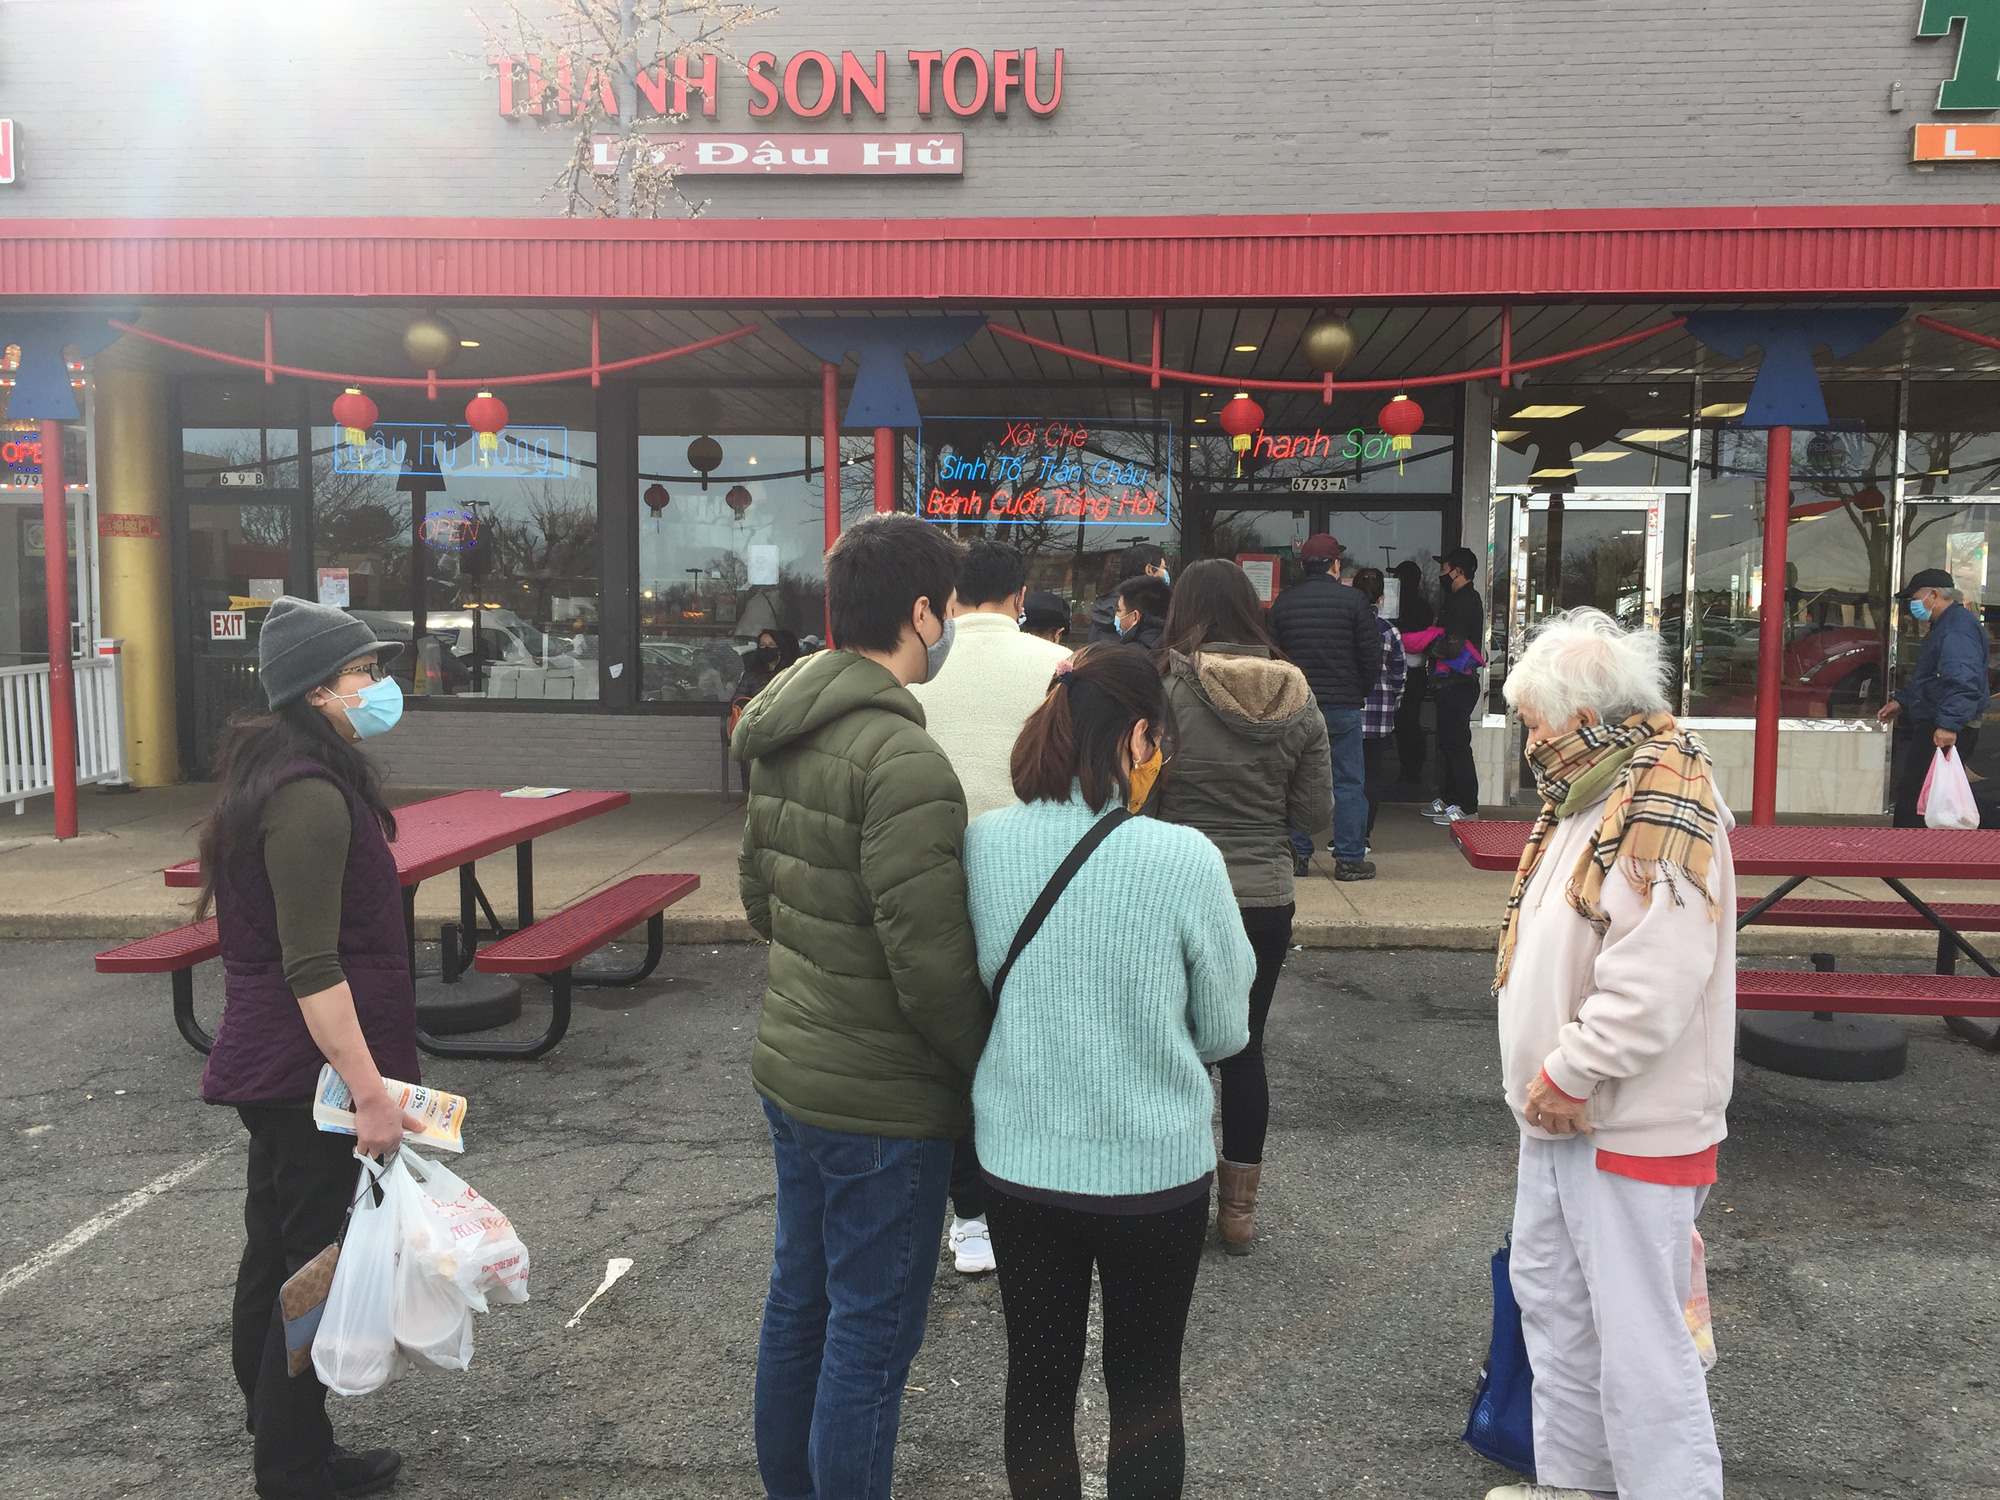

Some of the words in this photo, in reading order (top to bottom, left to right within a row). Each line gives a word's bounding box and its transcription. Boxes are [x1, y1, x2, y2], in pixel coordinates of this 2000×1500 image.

[487, 53, 717, 116] THANH
[747, 50, 886, 117] SON
[908, 47, 1065, 116] TOFU
[695, 140, 830, 171] Đậu
[862, 138, 955, 166] Hũ
[1000, 421, 1038, 446] Xôi
[1045, 422, 1088, 448] Chè
[1240, 428, 1330, 459] hanh
[1, 442, 43, 463] OPE
[940, 455, 987, 480] Sinh
[997, 453, 1026, 481] Tố
[1039, 456, 1083, 483] Trân
[1091, 459, 1147, 486] Châu
[1292, 478, 1347, 491] 6793-A
[927, 489, 982, 515] Bánh
[989, 487, 1046, 515] Cuốn
[1053, 489, 1111, 520] Tráng
[419, 518, 479, 542] OPEN
[213, 614, 243, 636] EXIT
